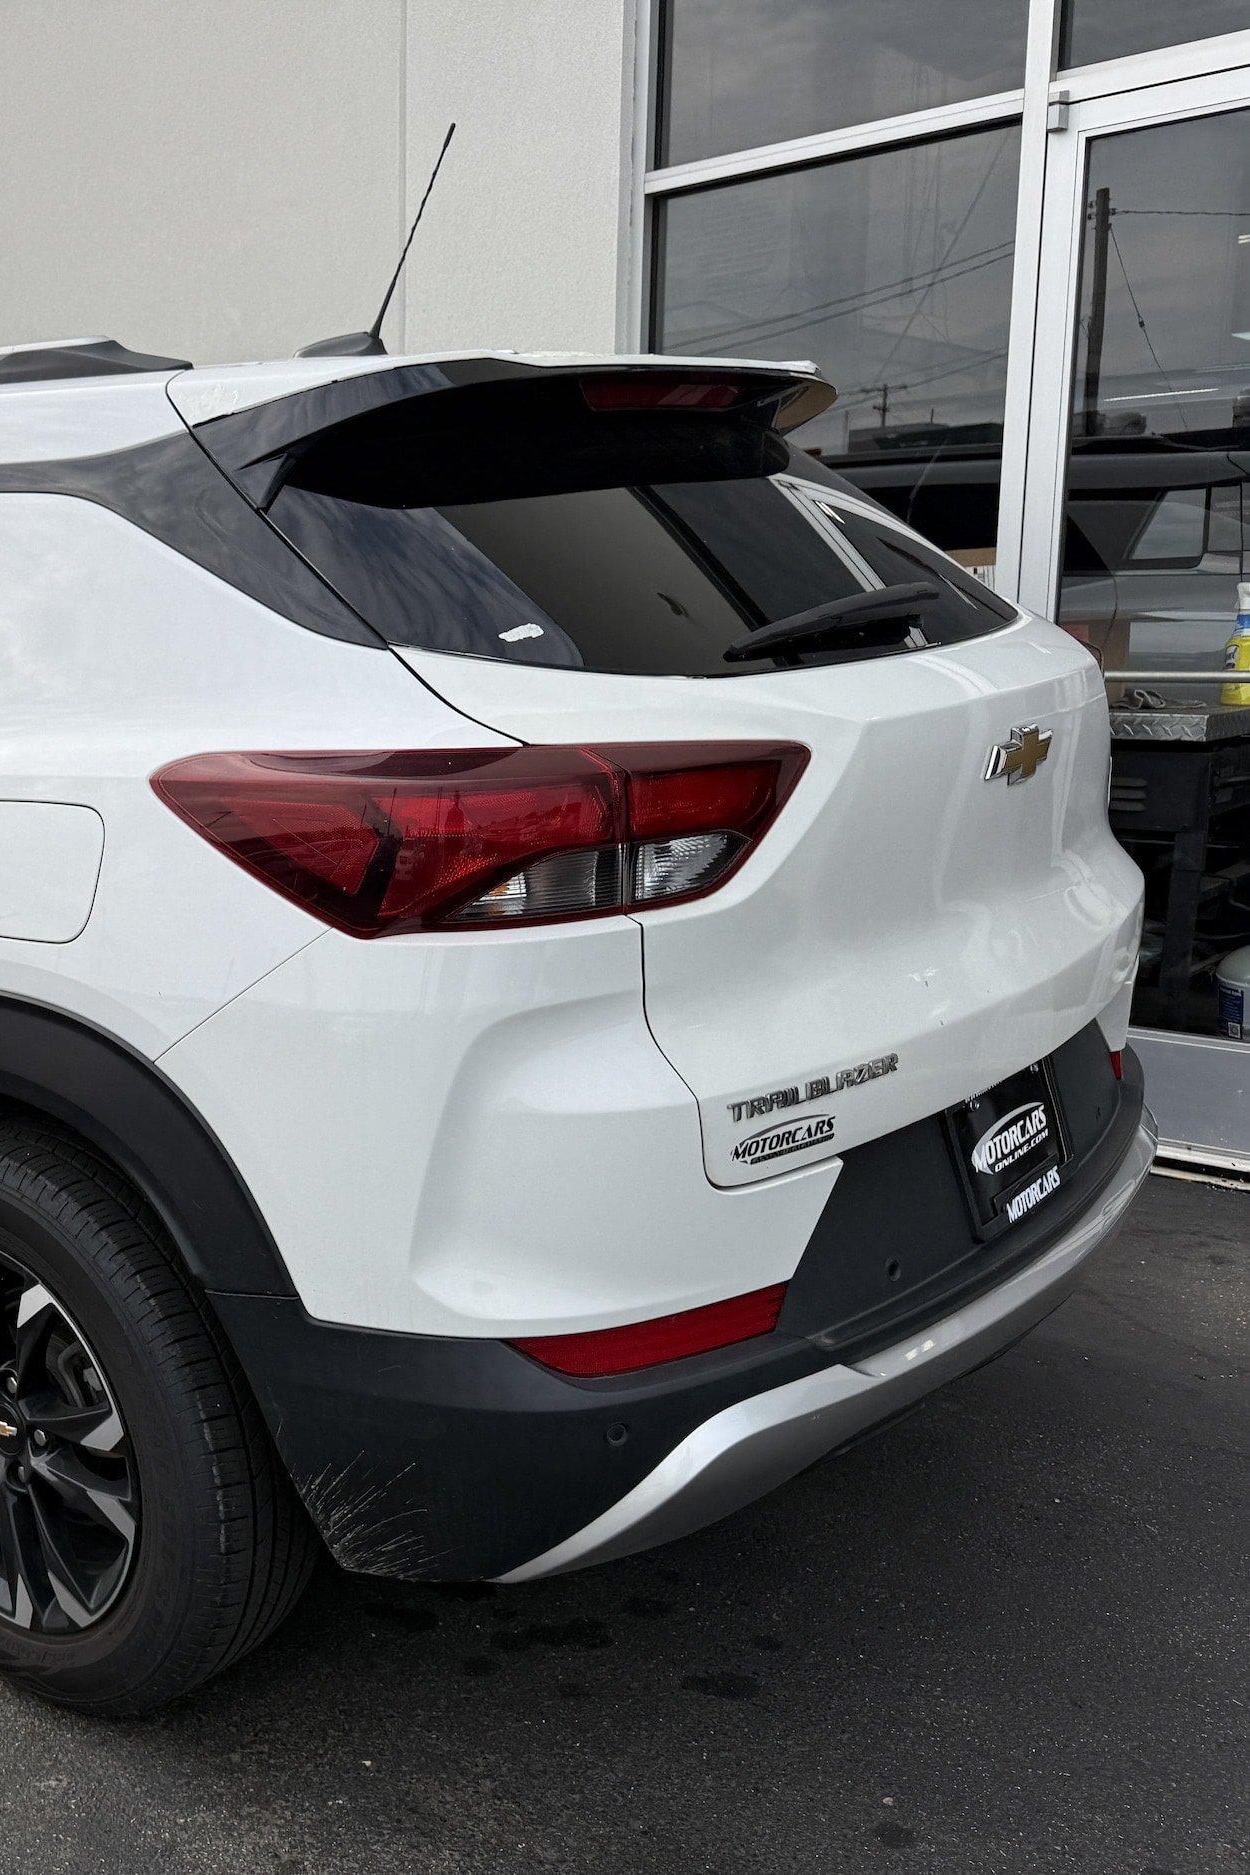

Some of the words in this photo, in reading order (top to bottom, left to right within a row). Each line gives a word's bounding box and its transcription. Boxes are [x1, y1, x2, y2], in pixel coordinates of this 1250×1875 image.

[726, 1053, 898, 1122] TRAILBLAZER
[731, 1115, 836, 1162] MOTORCARS
[971, 1104, 1047, 1173] MOTORCARS
[994, 1128, 1049, 1173] ONLINE.COM
[1005, 1165, 1061, 1224] MOTORCARS
